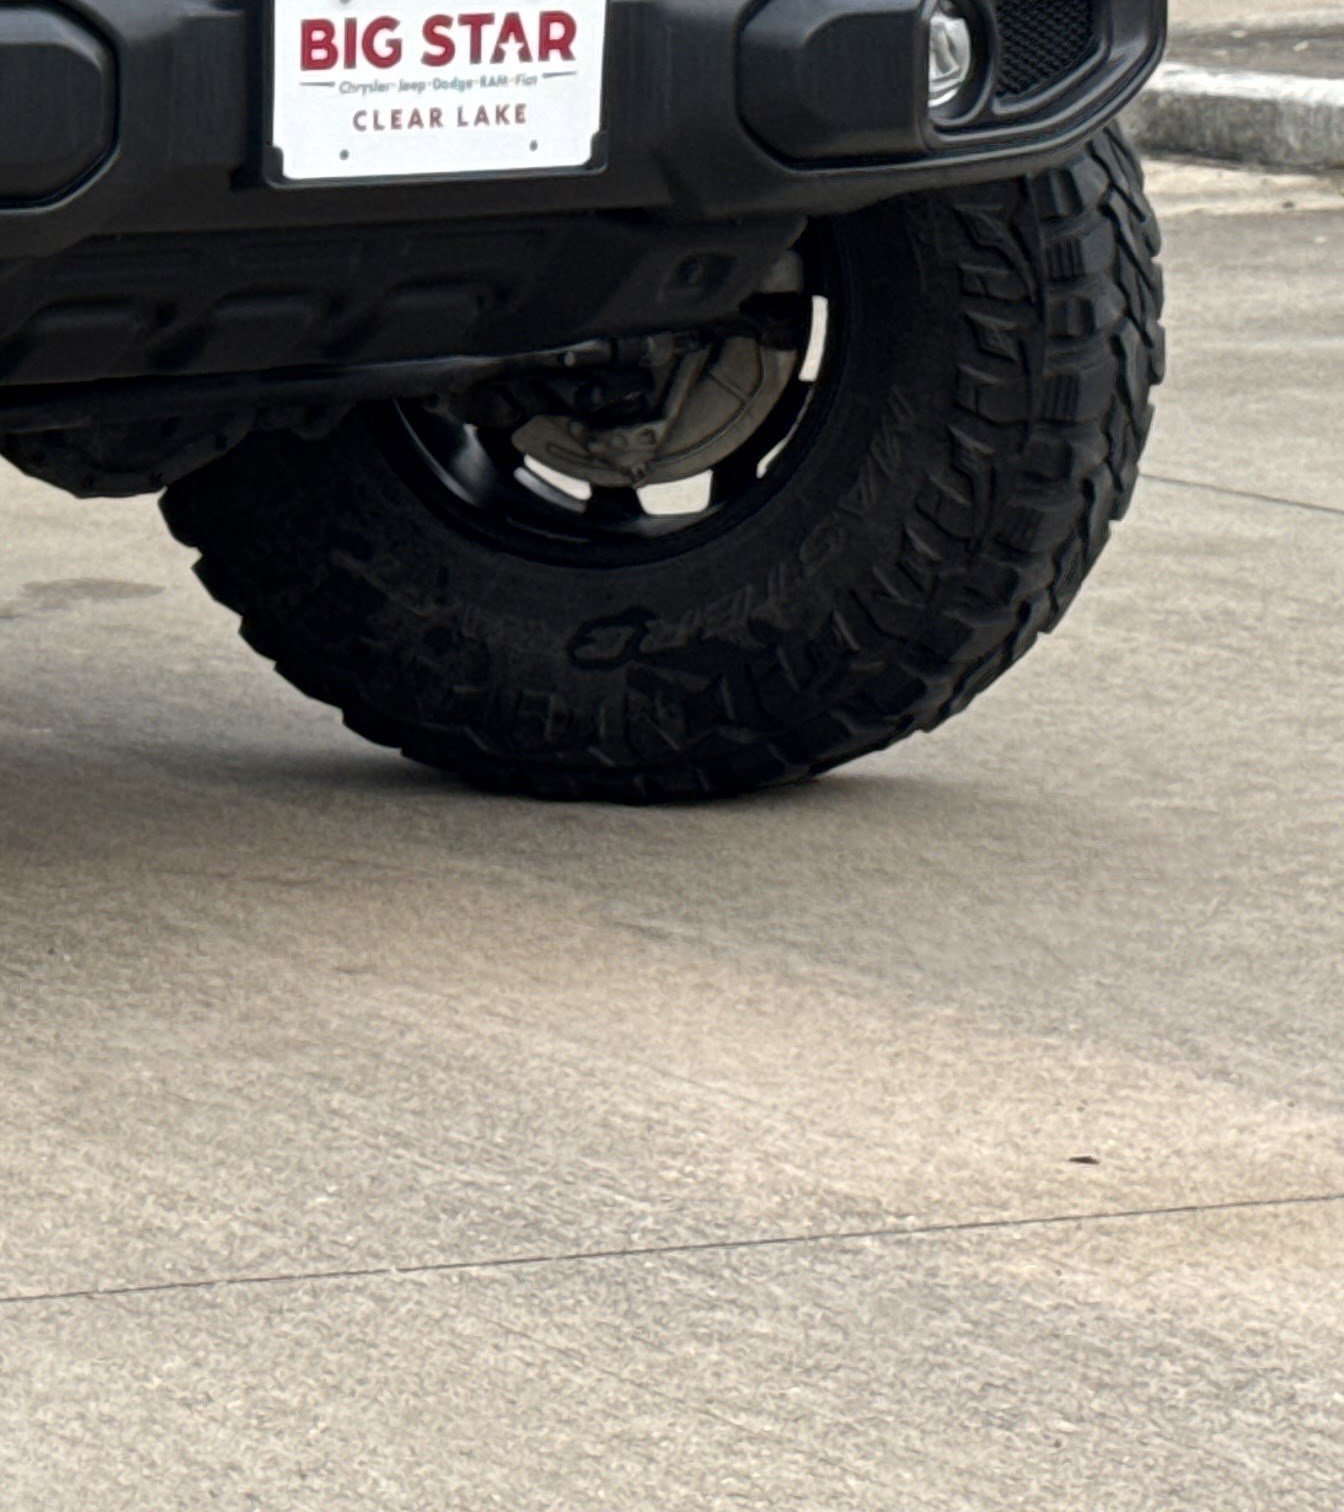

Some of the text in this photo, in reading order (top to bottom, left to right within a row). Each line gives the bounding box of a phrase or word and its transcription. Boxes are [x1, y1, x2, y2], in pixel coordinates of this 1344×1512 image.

[299, 10, 578, 71] BIG STAR
[352, 103, 527, 132] CLEAR LAKE
